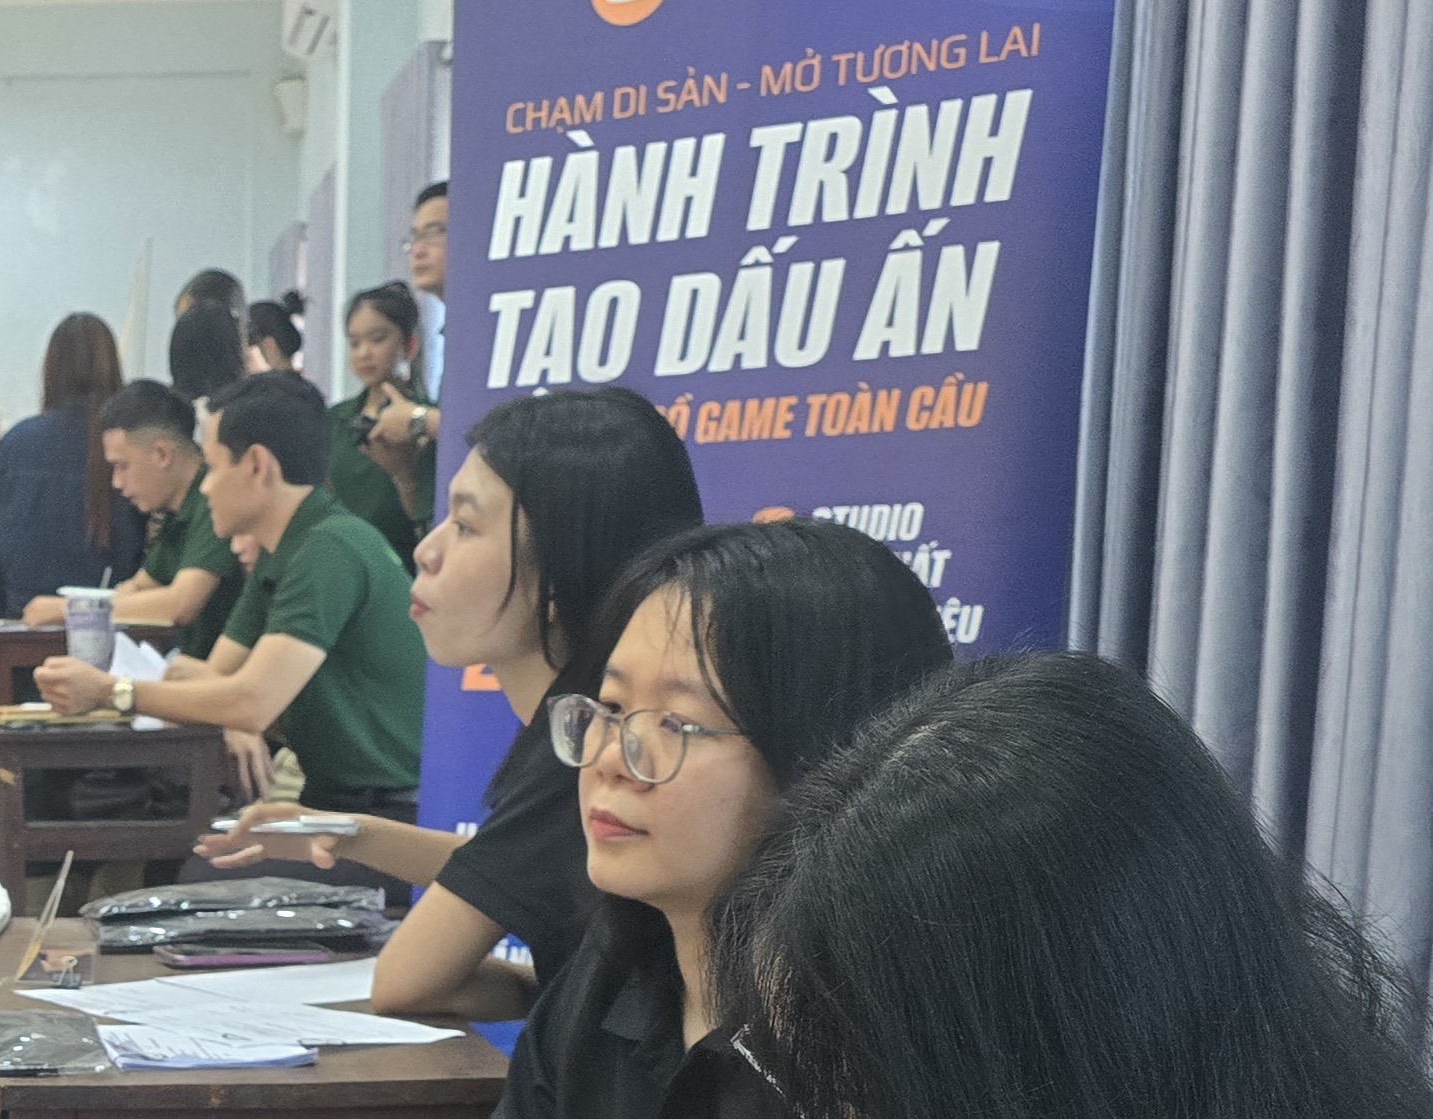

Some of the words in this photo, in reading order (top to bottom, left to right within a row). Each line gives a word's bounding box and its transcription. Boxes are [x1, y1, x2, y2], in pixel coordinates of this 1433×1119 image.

[505, 92, 604, 134] CHẠM
[612, 85, 646, 120] DI
[656, 66, 729, 113] SẢN
[759, 48, 822, 96] MỞ
[832, 34, 969, 84] TƯƠNG
[977, 22, 1042, 65] LAI
[487, 130, 727, 261] HÀNH
[745, 85, 1034, 232] TRÌNH
[486, 279, 642, 398] TẠO
[653, 235, 847, 378] DẤU
[851, 217, 1002, 362] ẤN
[695, 396, 799, 444] GAME
[804, 381, 903, 438] TOÀN
[905, 371, 989, 432] CẦU
[811, 502, 925, 542] TUDIO
